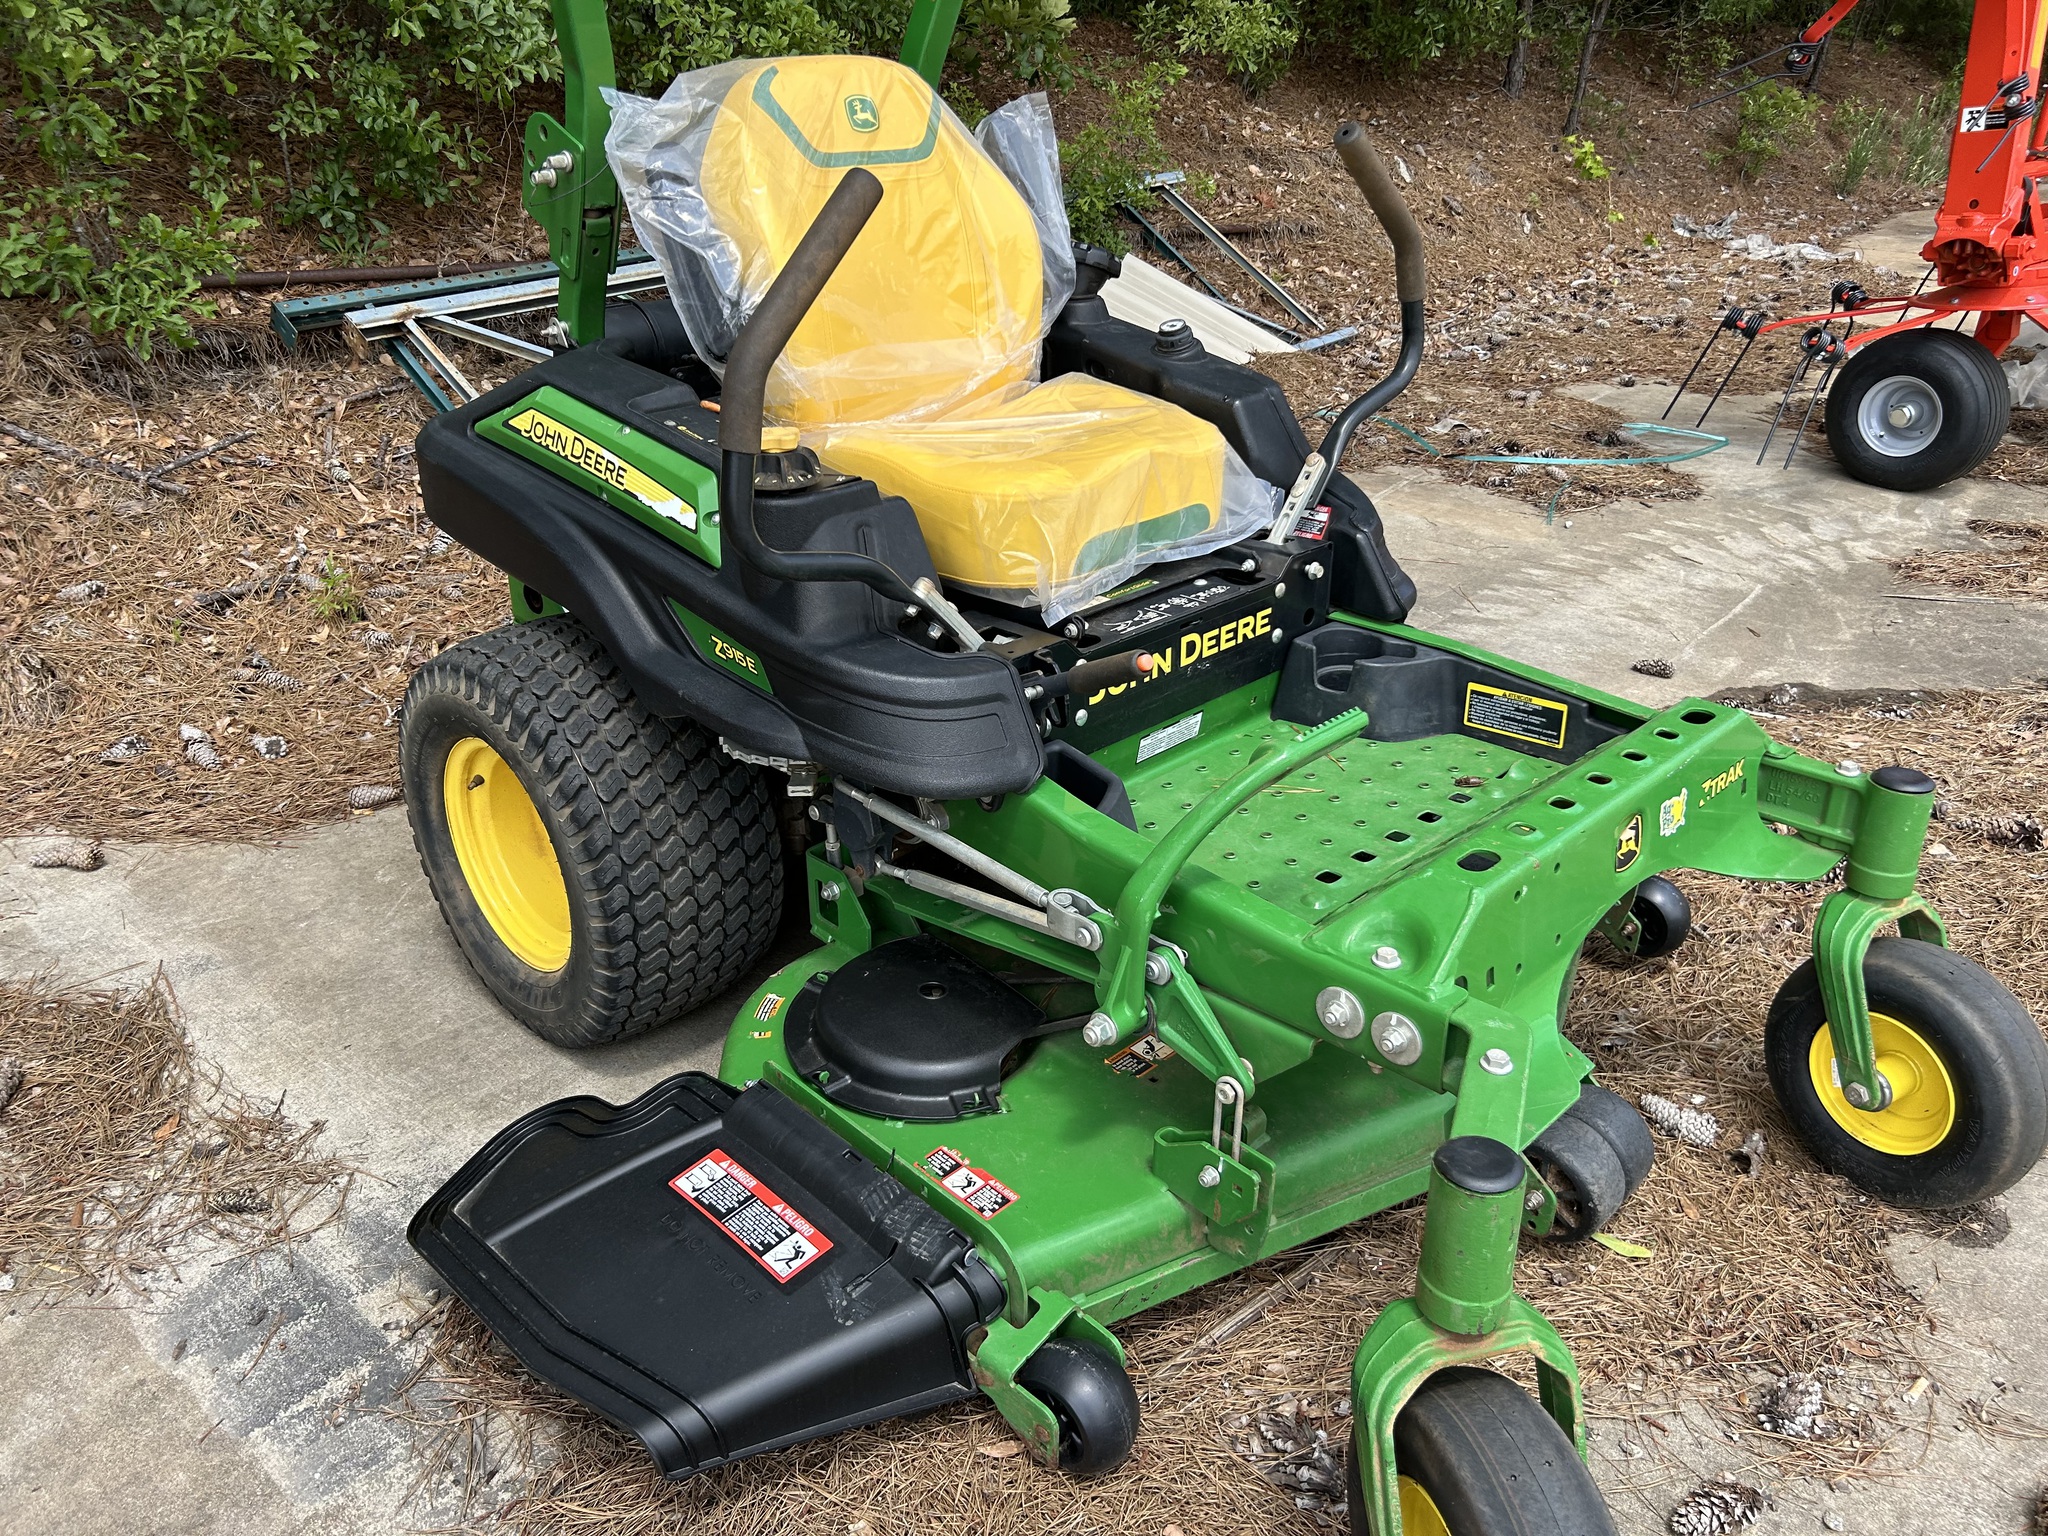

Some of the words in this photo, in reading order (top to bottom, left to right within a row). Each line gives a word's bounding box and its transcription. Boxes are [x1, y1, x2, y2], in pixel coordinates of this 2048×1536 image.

[523, 414, 568, 454] JOHN
[570, 435, 628, 488] DEERE
[709, 634, 759, 675] Z915E
[1179, 606, 1273, 669] DEERE
[726, 1163, 758, 1189] DANGER
[781, 1207, 816, 1238] PELIGRO
[678, 1231, 710, 1256] NOT
[706, 1253, 764, 1305] REMOVE
